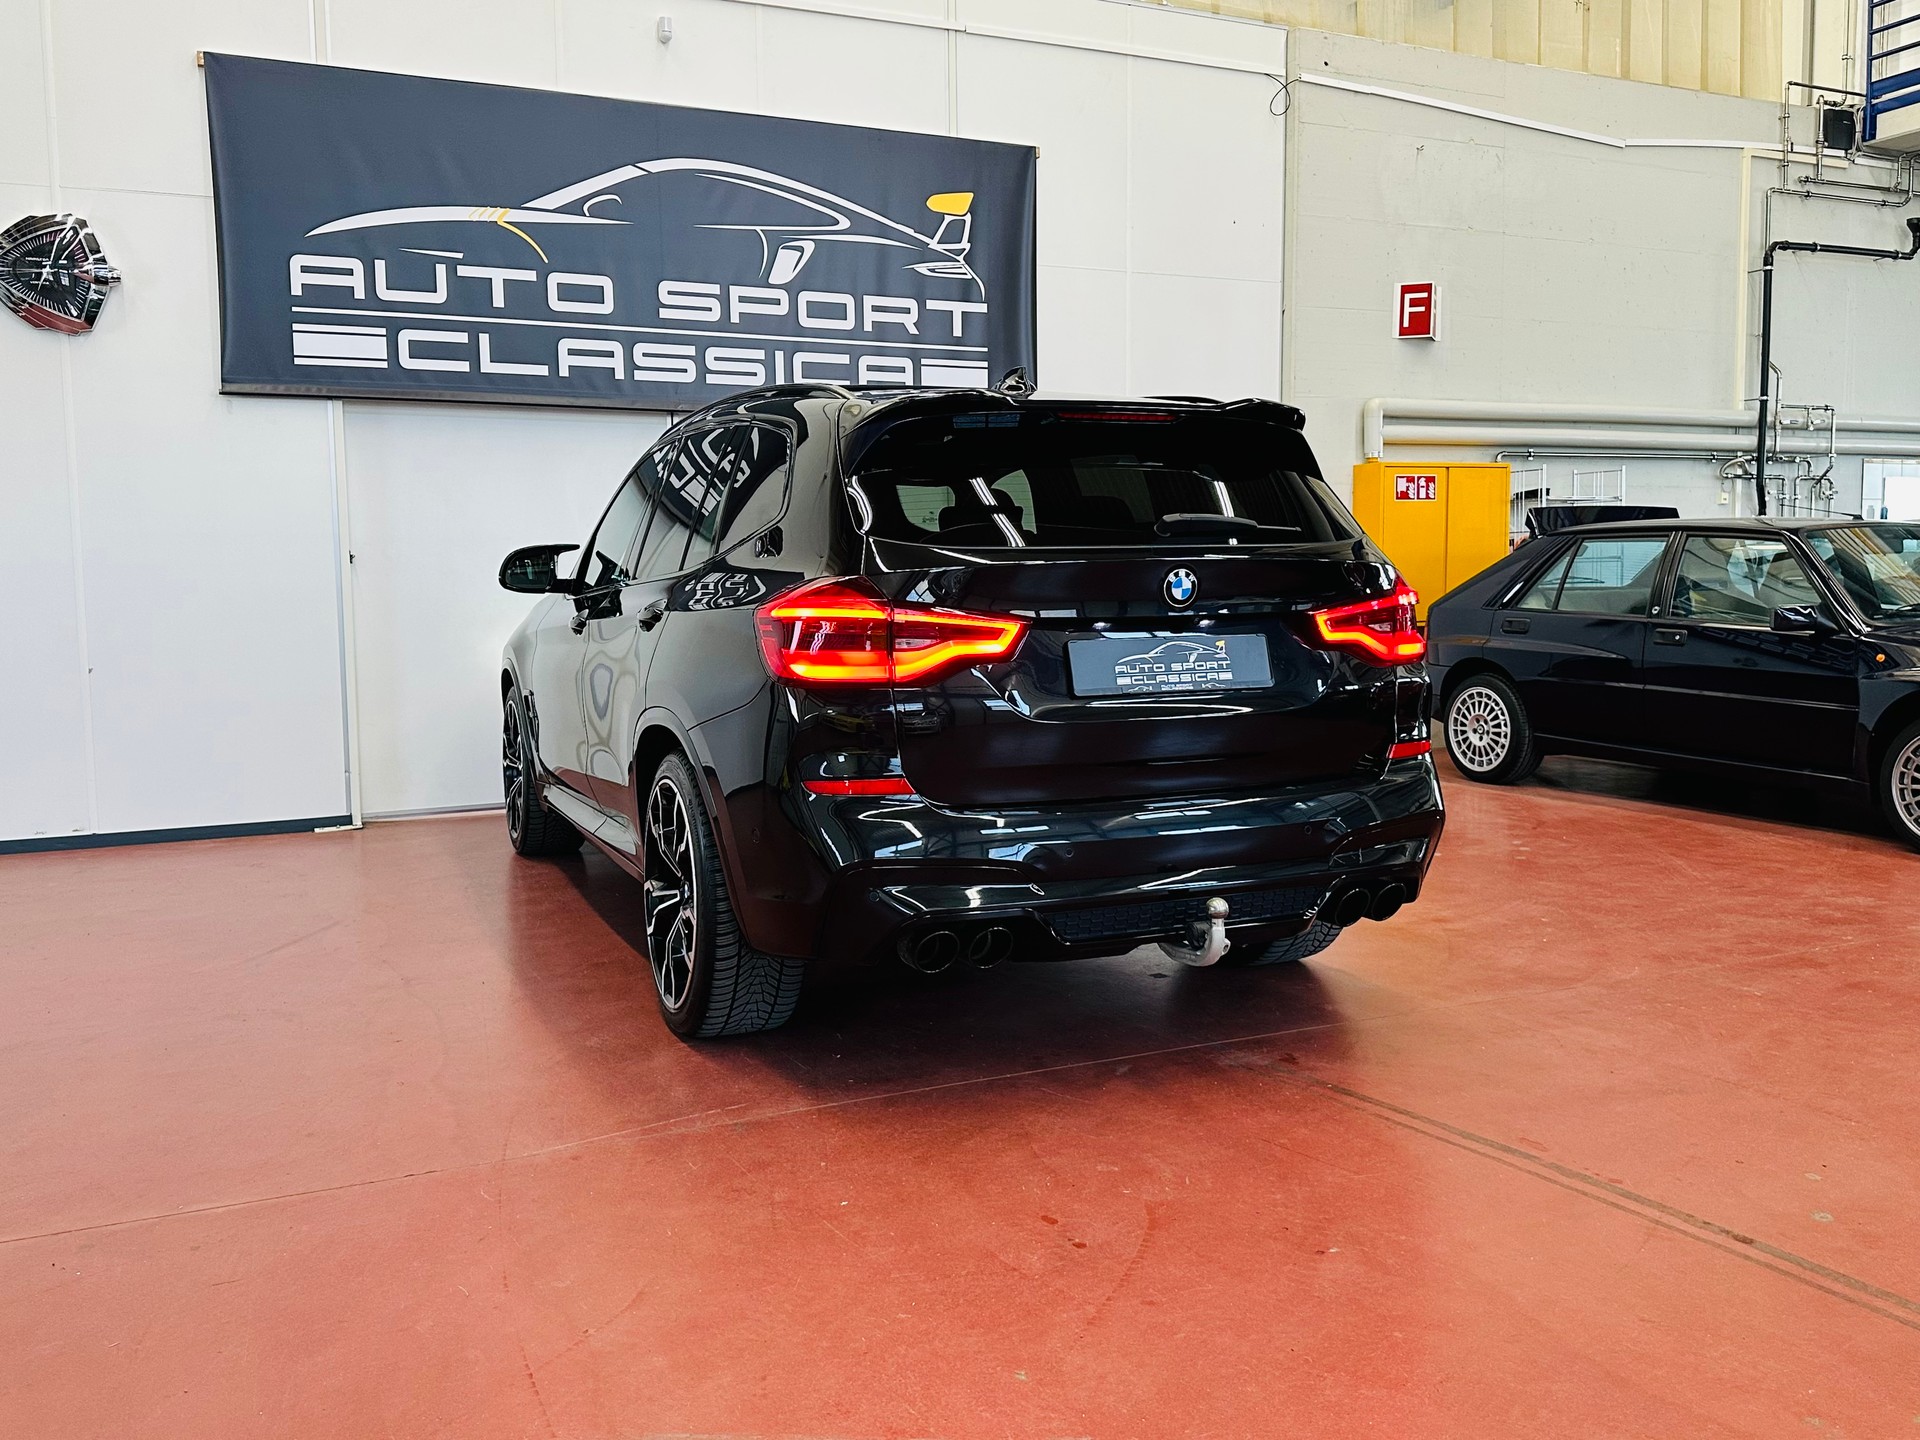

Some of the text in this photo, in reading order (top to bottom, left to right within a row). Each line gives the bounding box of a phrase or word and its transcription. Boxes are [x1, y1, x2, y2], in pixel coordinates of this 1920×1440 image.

[289, 254, 988, 338] AUTO SPORT
[1403, 292, 1428, 328] F
[397, 328, 915, 387] CLASSICA
[1115, 661, 1231, 674] AUTO SPORT
[1131, 672, 1220, 685] CLASSICA
